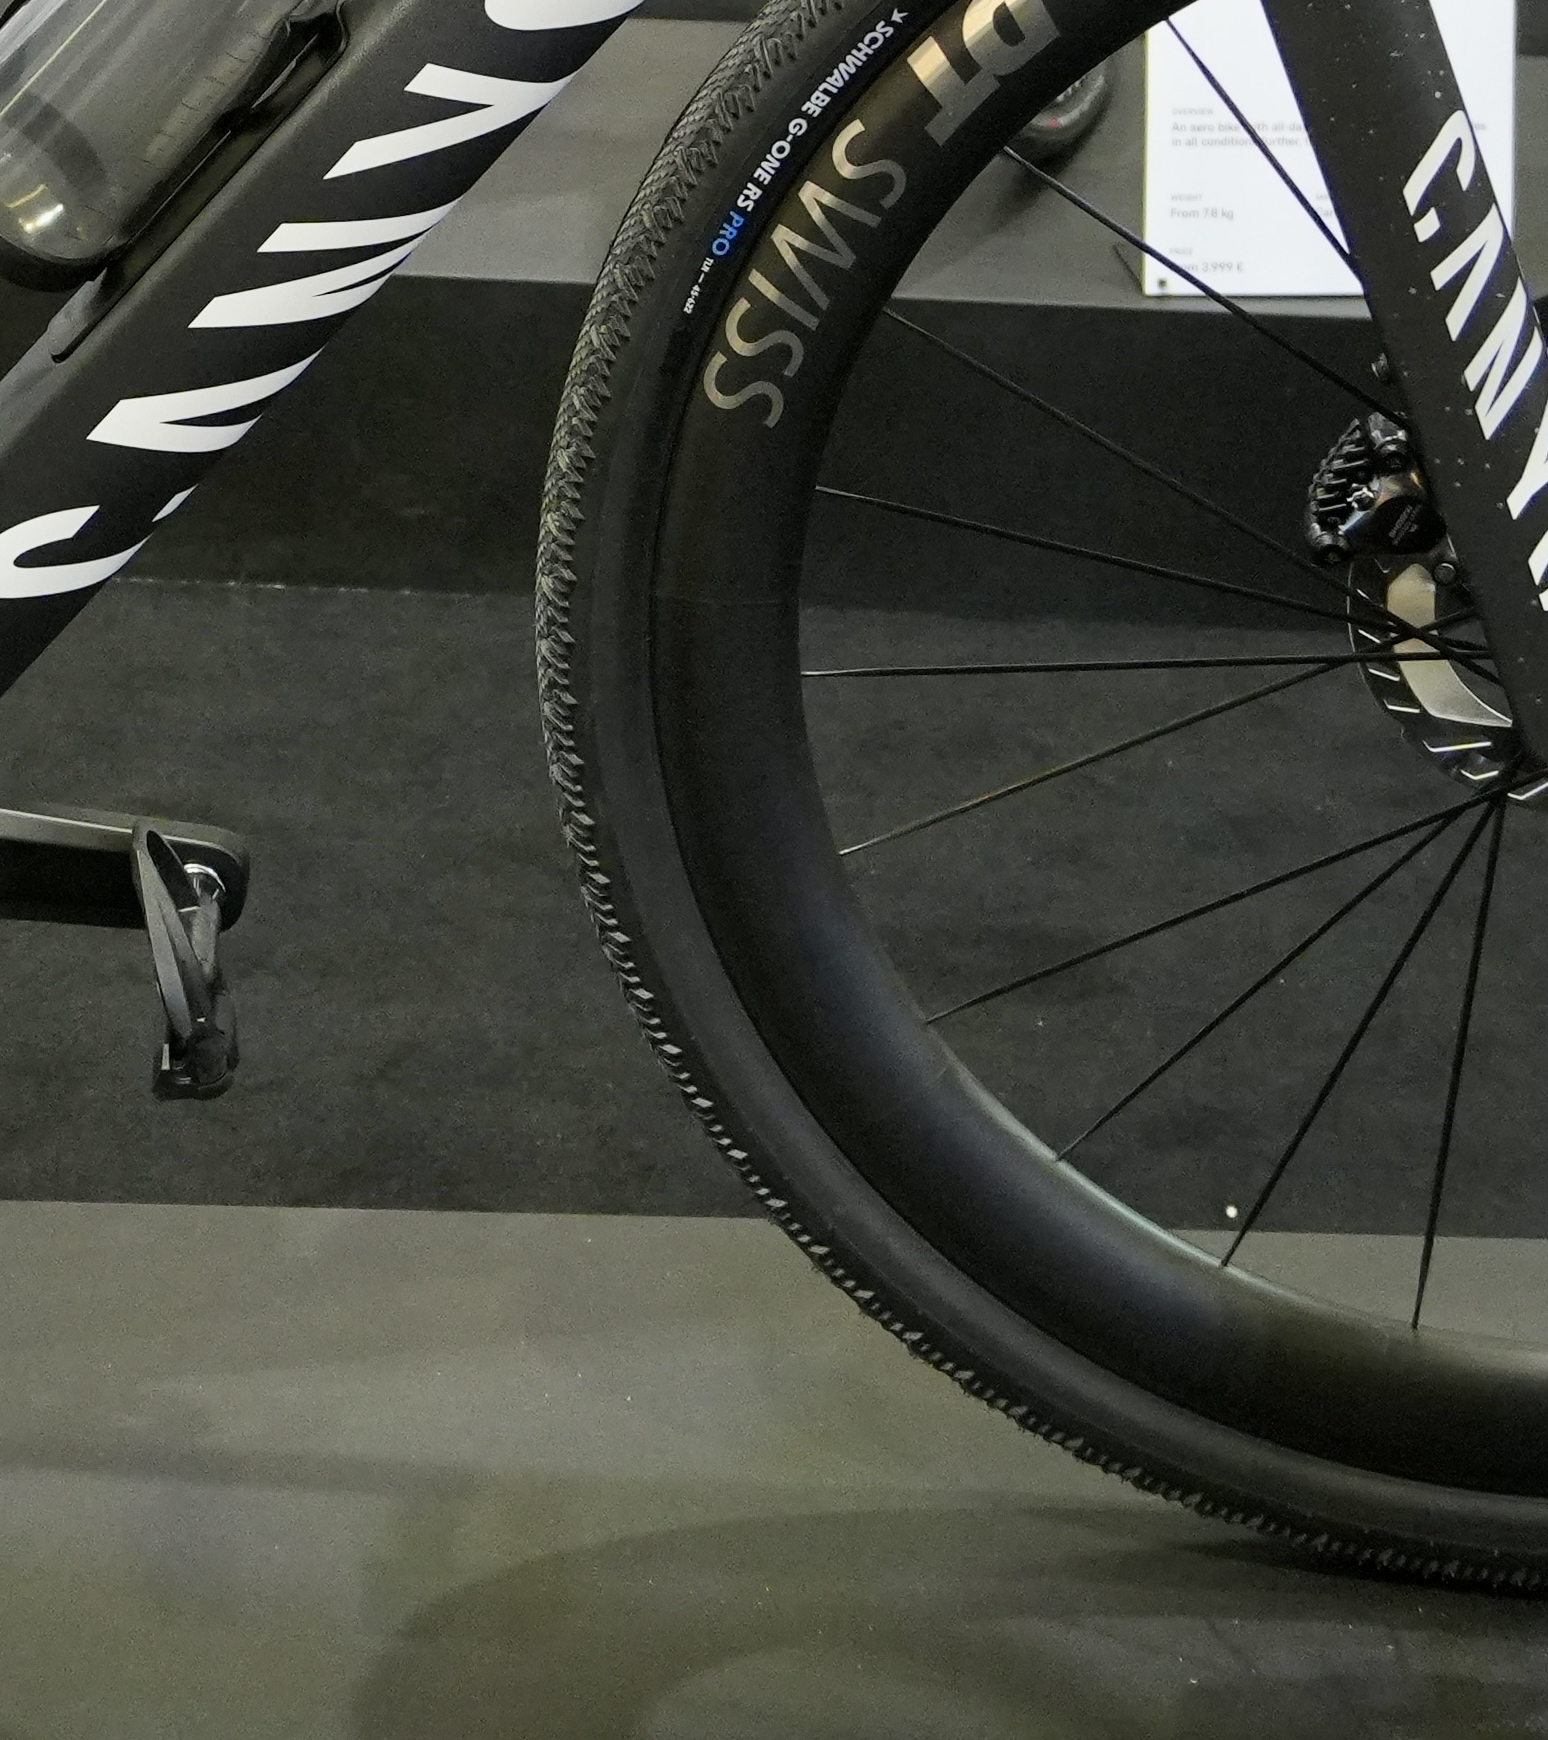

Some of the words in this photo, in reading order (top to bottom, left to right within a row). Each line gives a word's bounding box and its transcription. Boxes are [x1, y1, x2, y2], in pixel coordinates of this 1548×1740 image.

[800, 21, 894, 120] SCHWALBE
[1172, 121, 1187, 133] An
[1190, 123, 1214, 133] aero
[1217, 121, 1240, 133] bike
[1172, 136, 1184, 148] in
[1185, 136, 1198, 148] all
[1201, 136, 1256, 148] condition
[756, 116, 809, 186] G-ONE
[735, 182, 761, 214] RS
[1170, 207, 1199, 219] From
[1221, 206, 1234, 222] kg
[710, 208, 747, 258] PRO
[704, 119, 905, 428] SWISS
